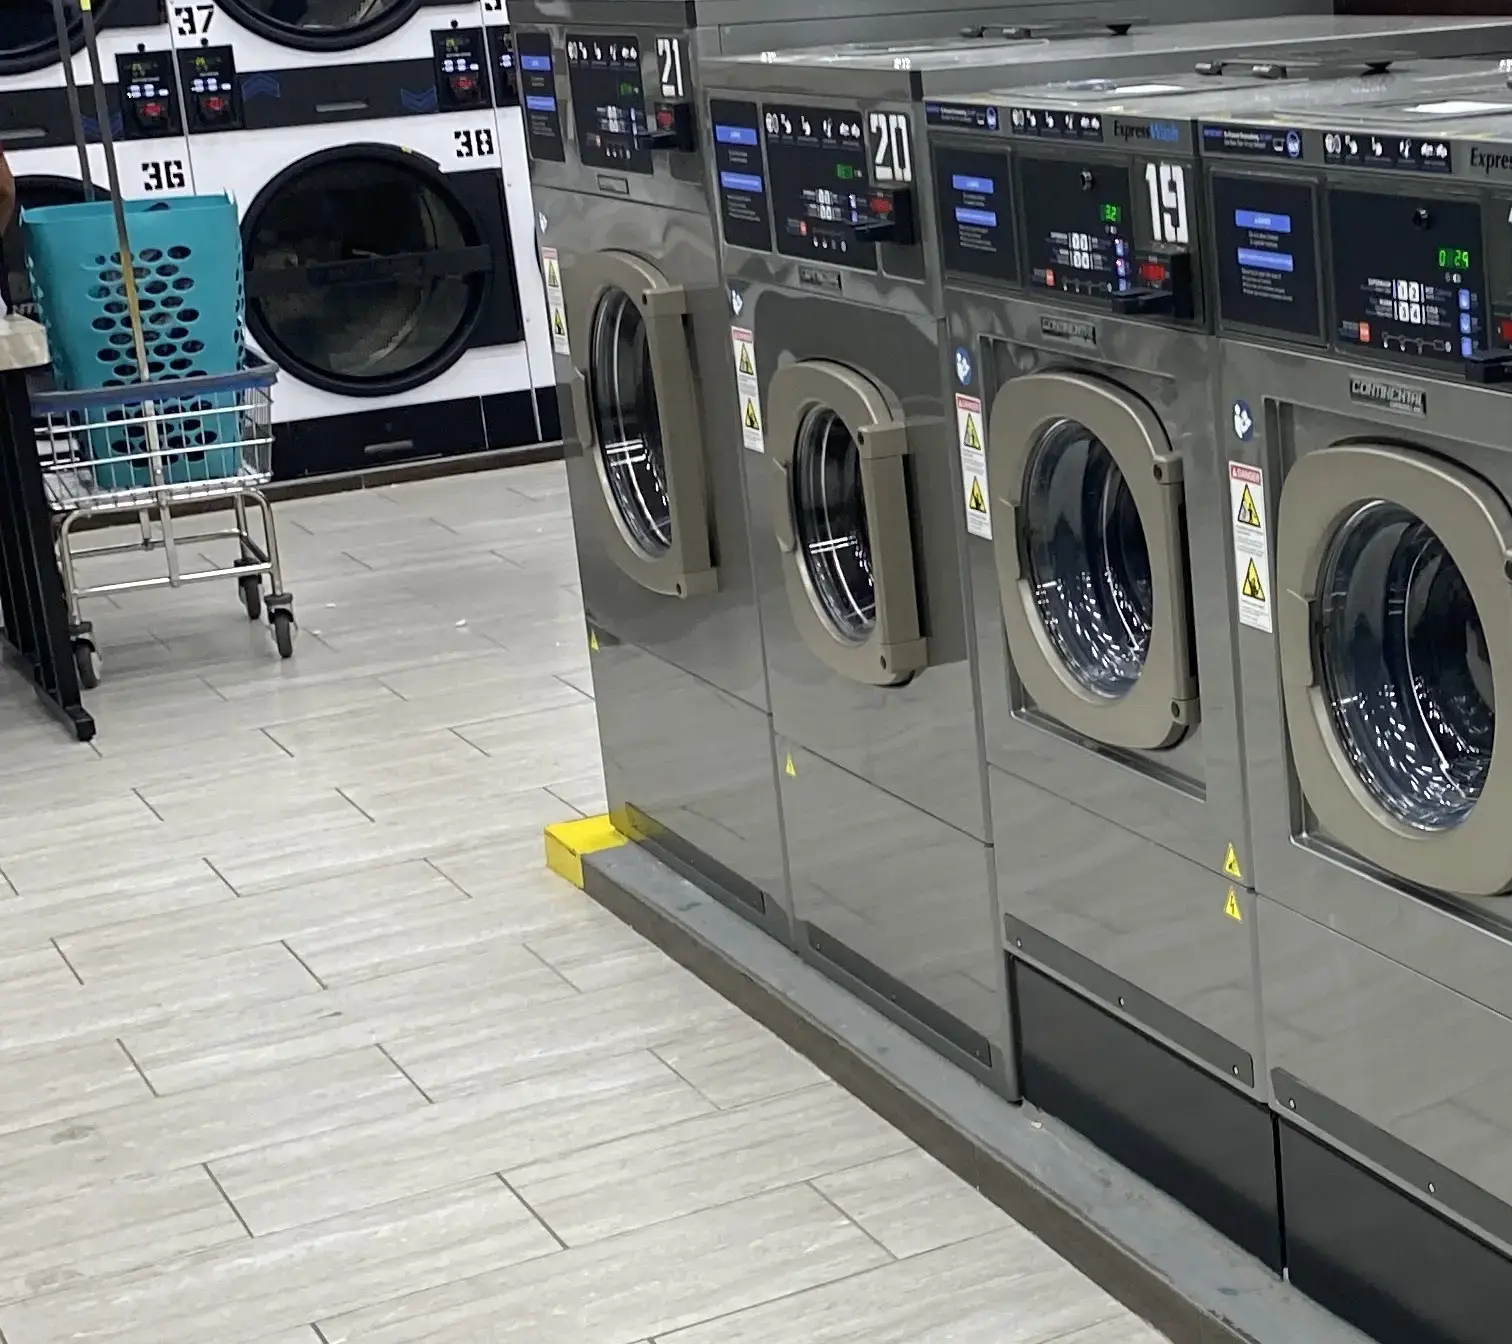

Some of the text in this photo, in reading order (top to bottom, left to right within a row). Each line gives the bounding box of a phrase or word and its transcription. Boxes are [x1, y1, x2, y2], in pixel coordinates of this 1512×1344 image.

[174, 5, 214, 36] 37
[656, 38, 684, 97] 21
[454, 128, 494, 158] 38
[869, 112, 912, 182] 20
[1114, 121, 1180, 144] ExpressWash
[141, 160, 185, 191] 36
[1144, 162, 1189, 244] 19
